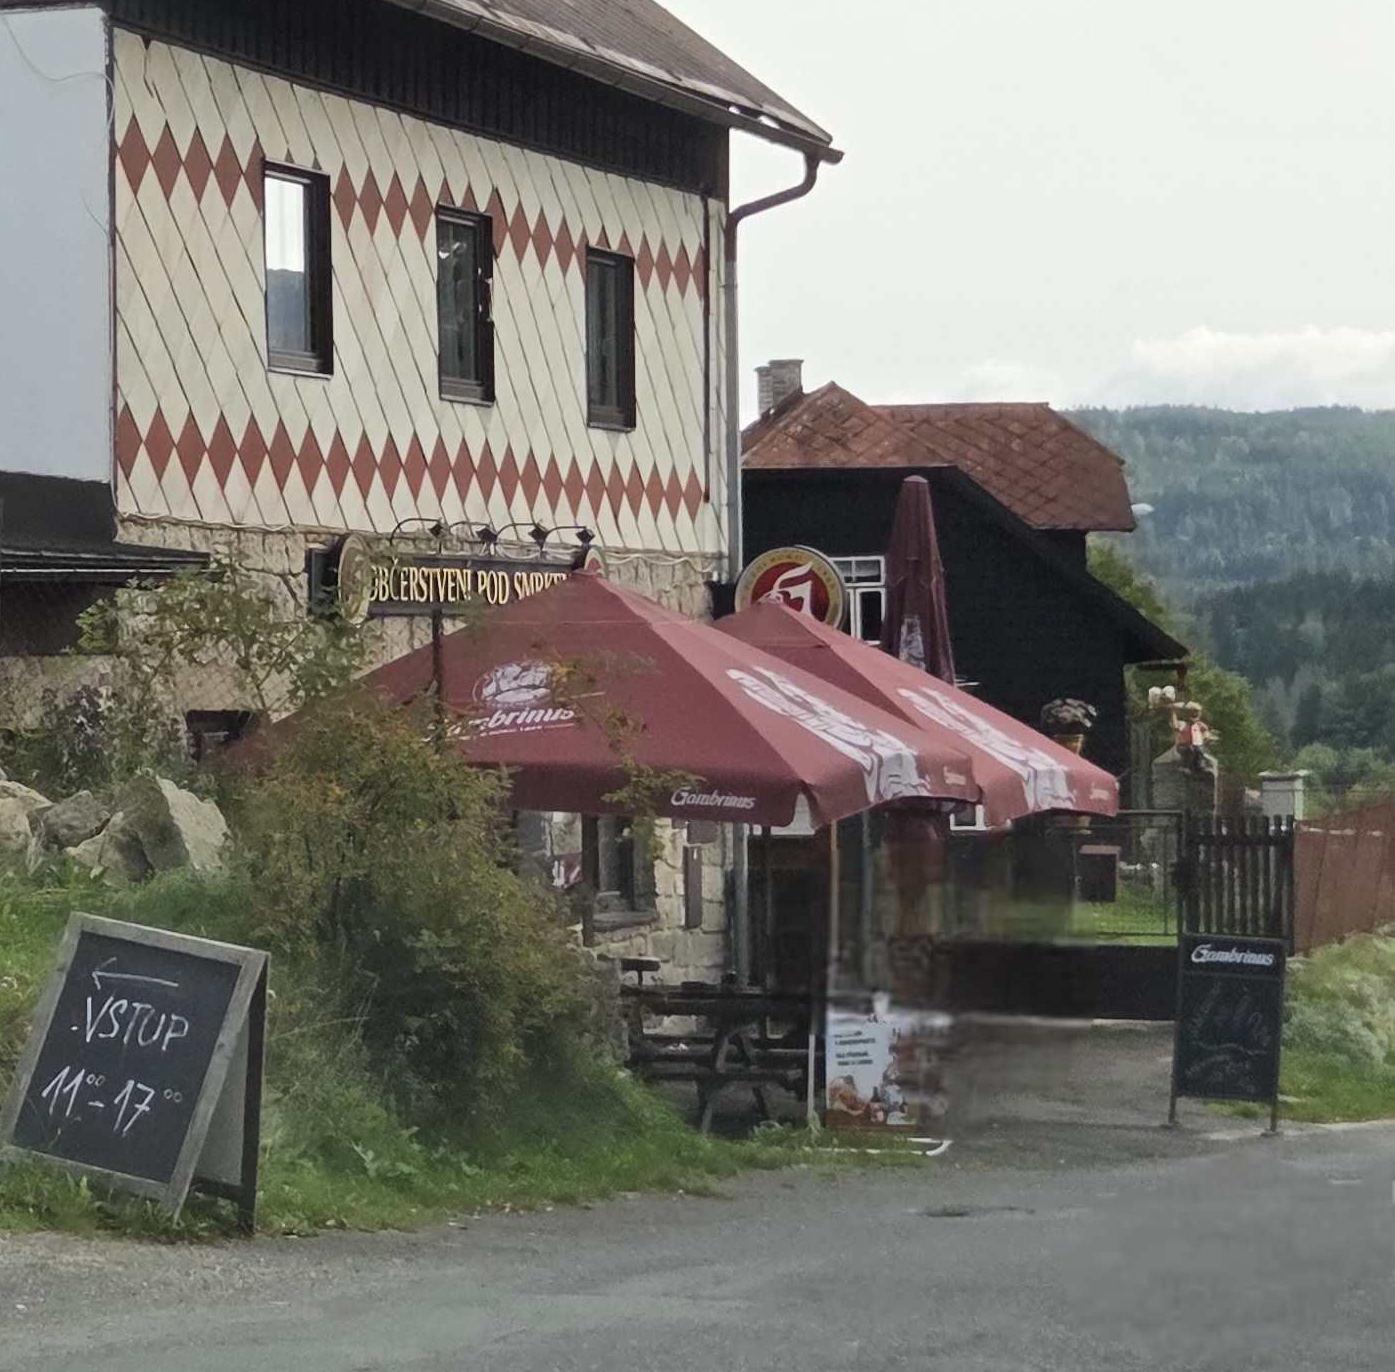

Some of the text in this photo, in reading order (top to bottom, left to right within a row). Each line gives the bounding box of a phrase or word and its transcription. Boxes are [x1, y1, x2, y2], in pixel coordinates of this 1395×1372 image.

[477, 570, 510, 605] POD
[670, 786, 756, 809] Gambrinus
[1191, 943, 1275, 966] Gambrinus
[85, 995, 190, 1052] VSTUP
